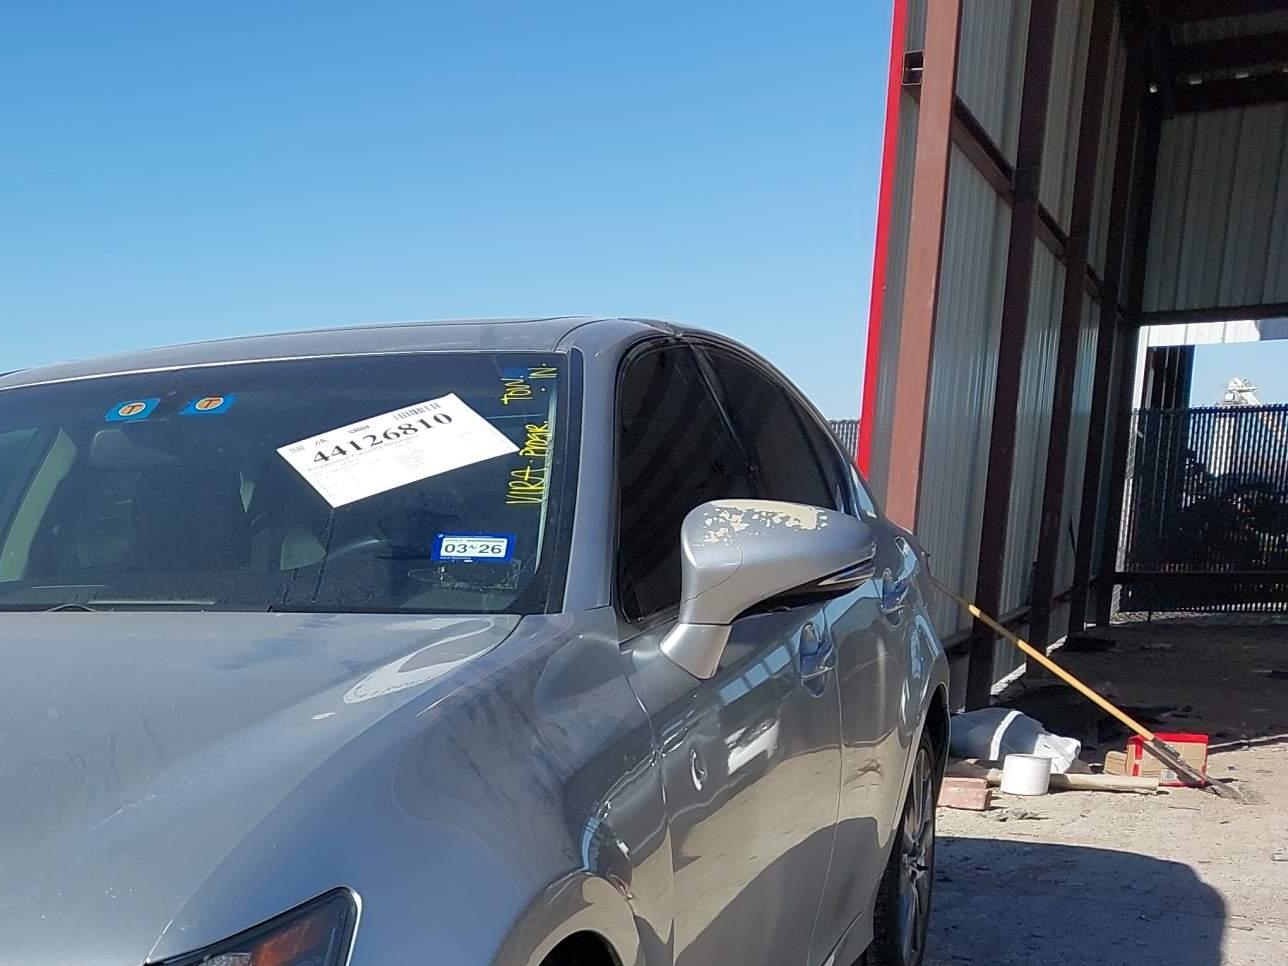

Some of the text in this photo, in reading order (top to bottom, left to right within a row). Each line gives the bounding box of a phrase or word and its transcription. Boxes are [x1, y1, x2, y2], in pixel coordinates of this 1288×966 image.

[313, 413, 453, 463] 44126810
[444, 543, 502, 555] 03 26
